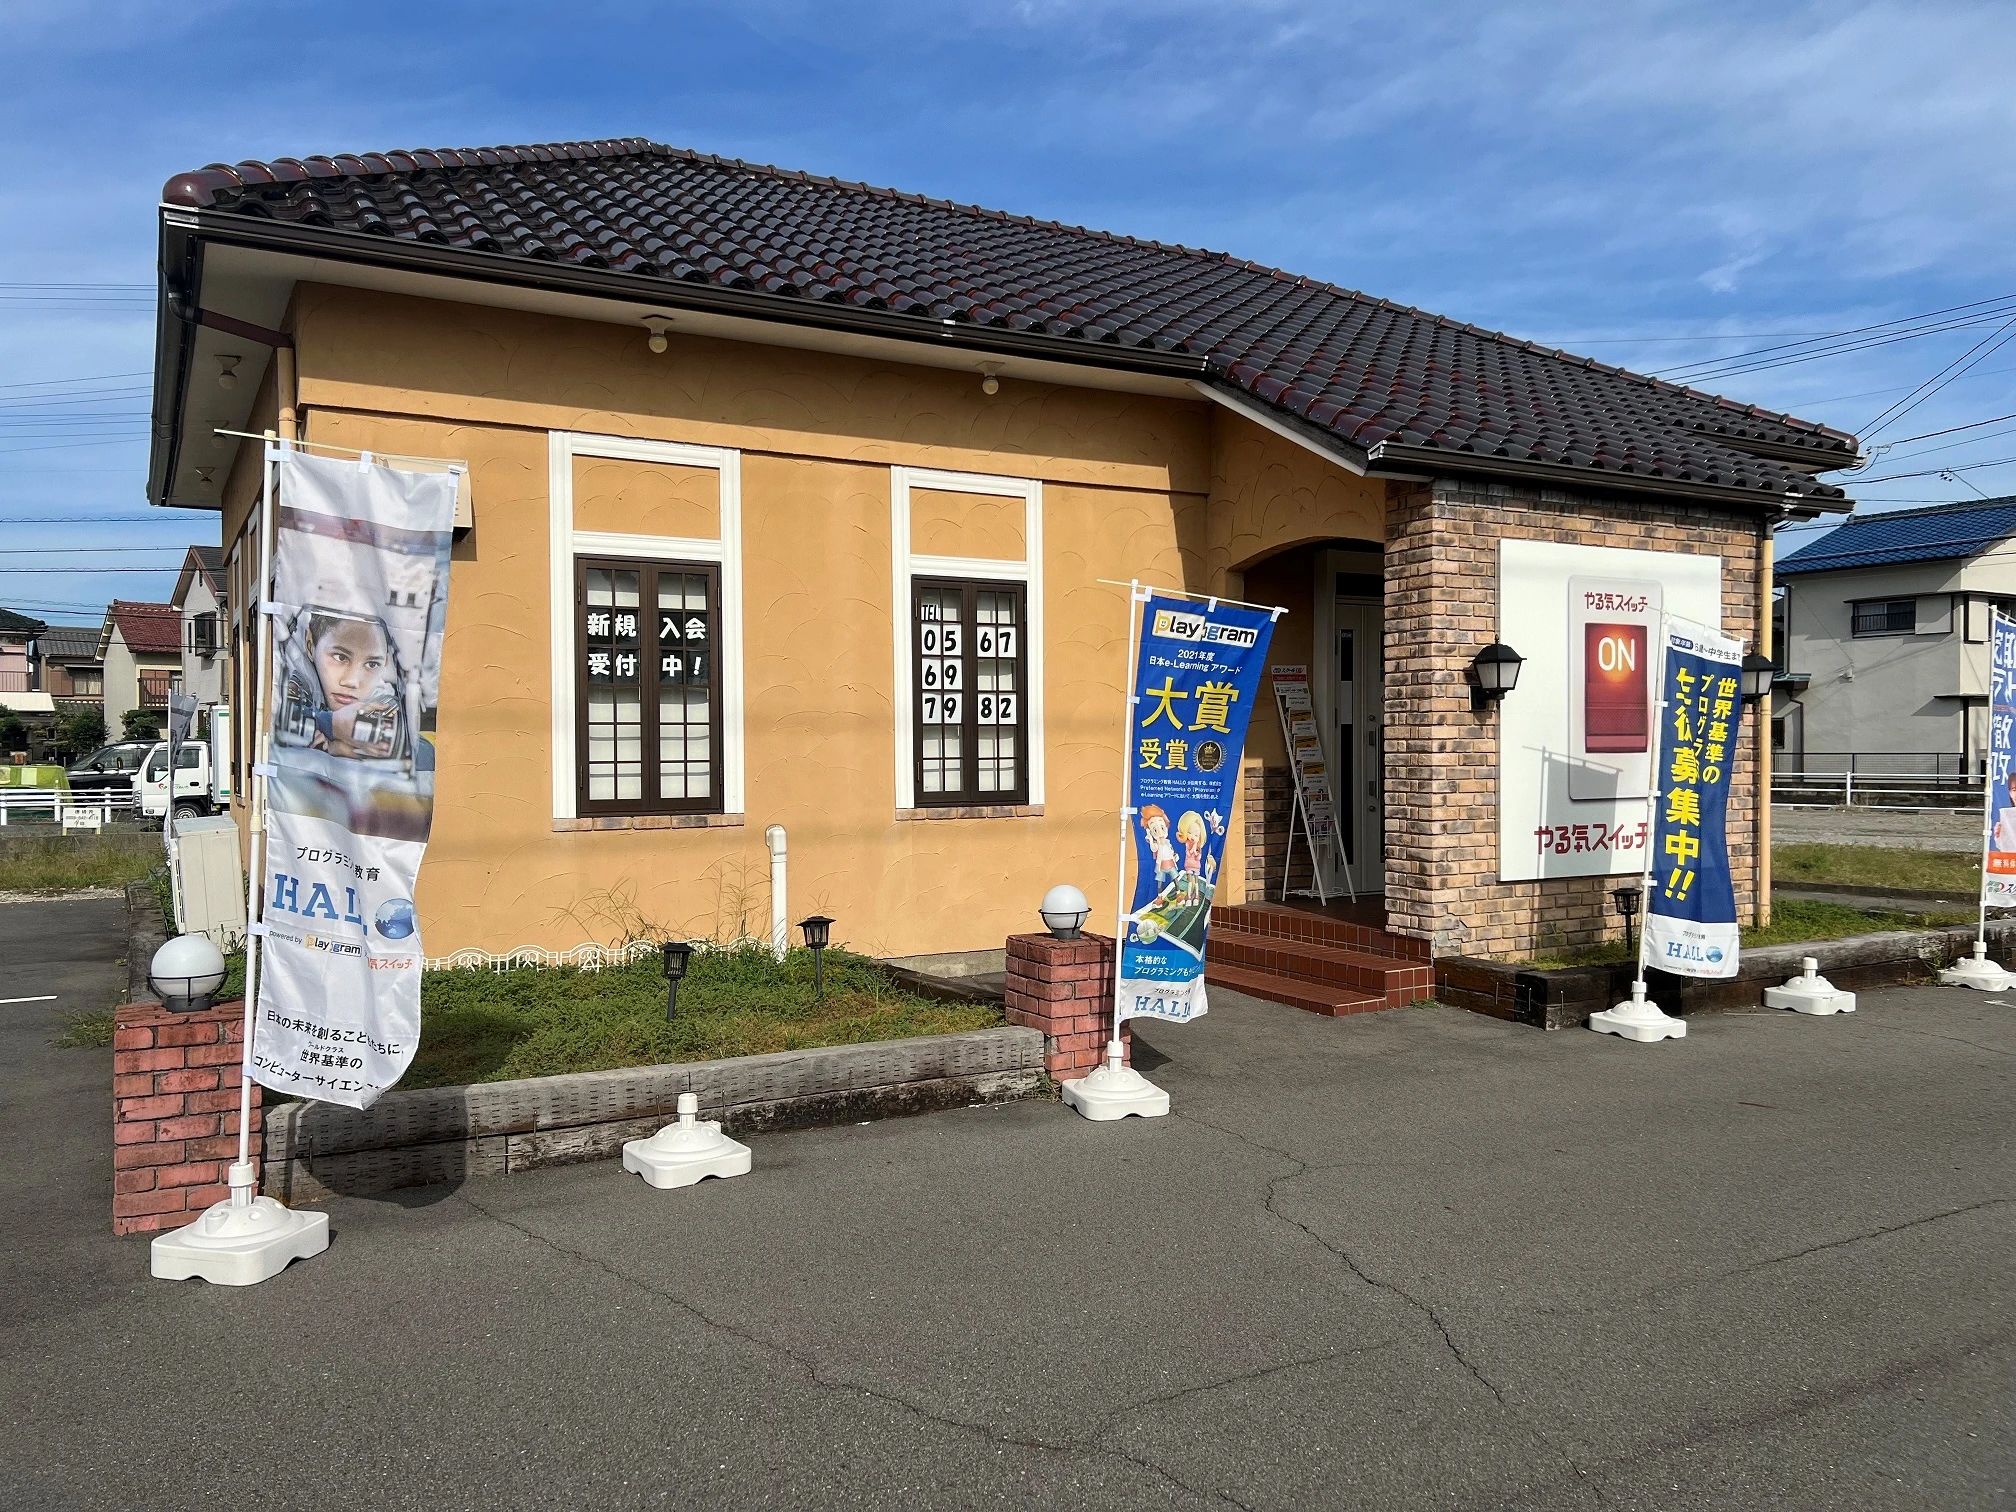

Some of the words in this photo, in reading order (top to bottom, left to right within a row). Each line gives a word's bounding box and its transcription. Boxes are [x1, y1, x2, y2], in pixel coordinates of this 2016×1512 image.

[922, 604, 939, 621] TEL
[1584, 591, 1648, 613] やる気スイッチ
[1177, 649, 1216, 662] 2021年度
[1597, 635, 1636, 672] ON
[924, 664, 958, 687] 69
[1210, 664, 1243, 675] アワード
[1141, 675, 1240, 734] 大賞
[1702, 677, 1738, 785] 世界基準の
[1139, 738, 1189, 771] 受賞
[1534, 822, 1648, 855] やる気スイッチ
[294, 937, 303, 945] by
[1135, 955, 1168, 965] 本格的な
[300, 1049, 363, 1070] 世界基準の
